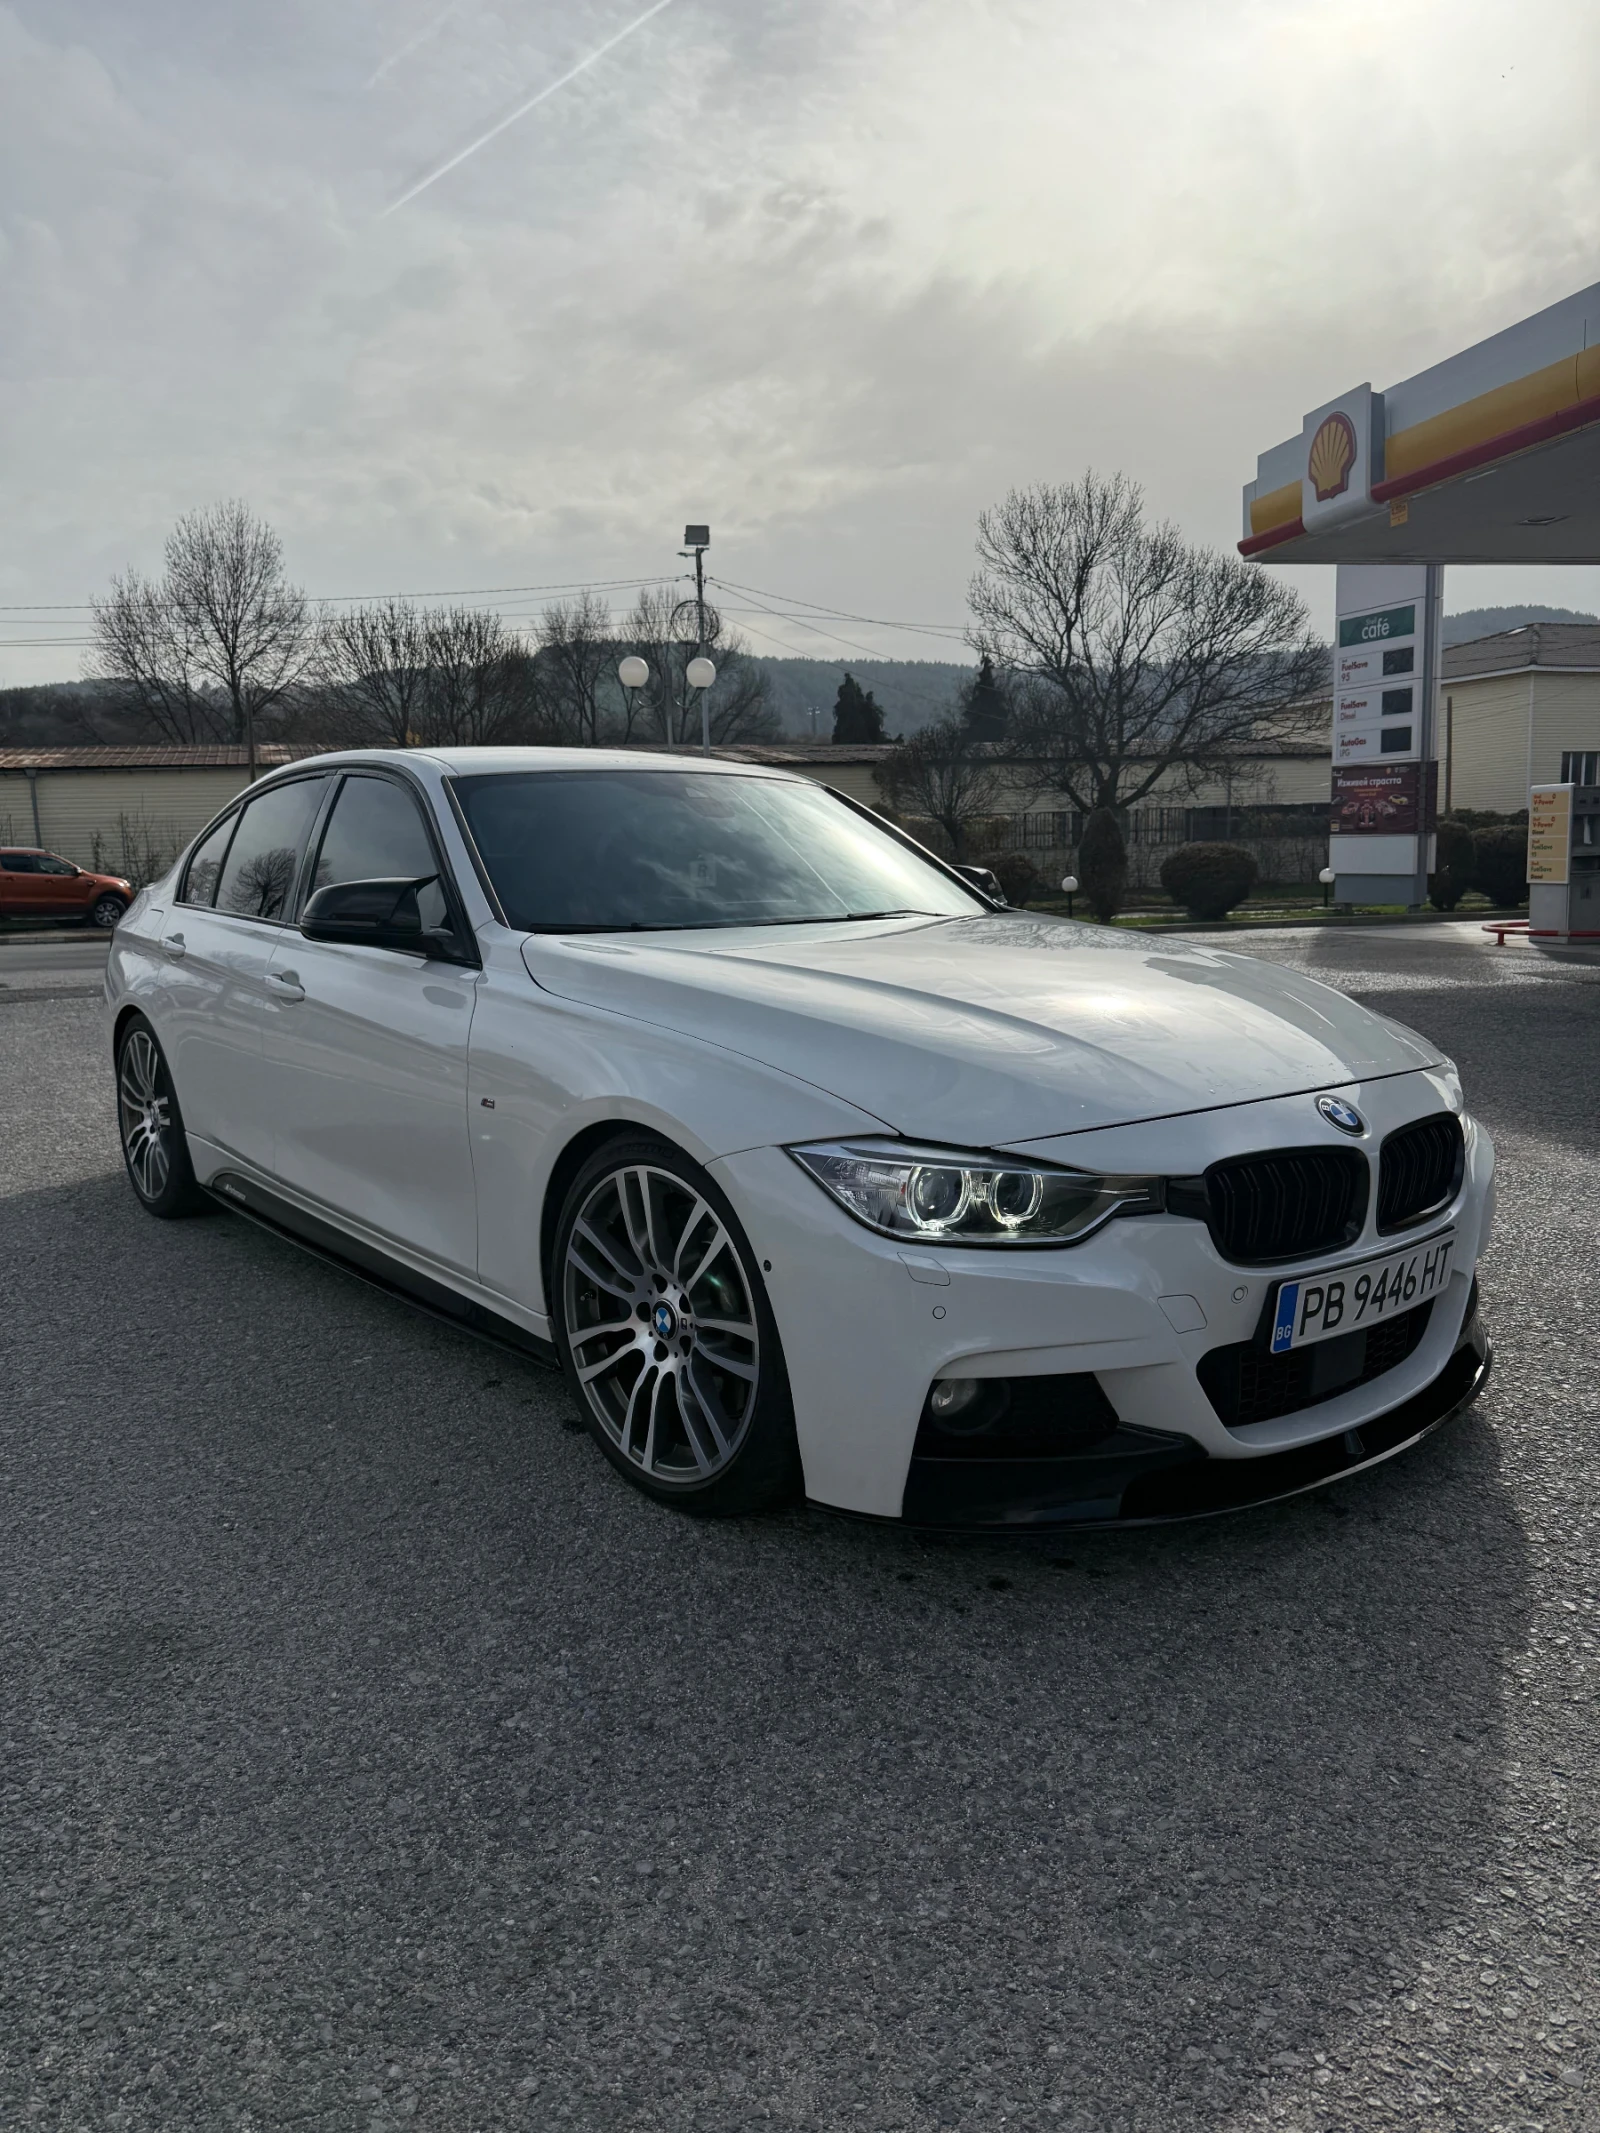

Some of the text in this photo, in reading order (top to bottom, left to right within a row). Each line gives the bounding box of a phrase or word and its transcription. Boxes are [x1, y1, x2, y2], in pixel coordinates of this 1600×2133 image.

[1361, 617, 1389, 640] café
[1341, 661, 1368, 671] FuelSave
[1341, 672, 1350, 681] 95
[1340, 700, 1368, 710] FuelSave
[1340, 710, 1356, 720] Diesel
[1340, 738, 1366, 747] AutoGas
[1340, 748, 1350, 757] LPG
[1369, 777, 1402, 788] страстта
[1299, 1240, 1454, 1337] PB 9446 HT
[1276, 1325, 1292, 1341] BG
